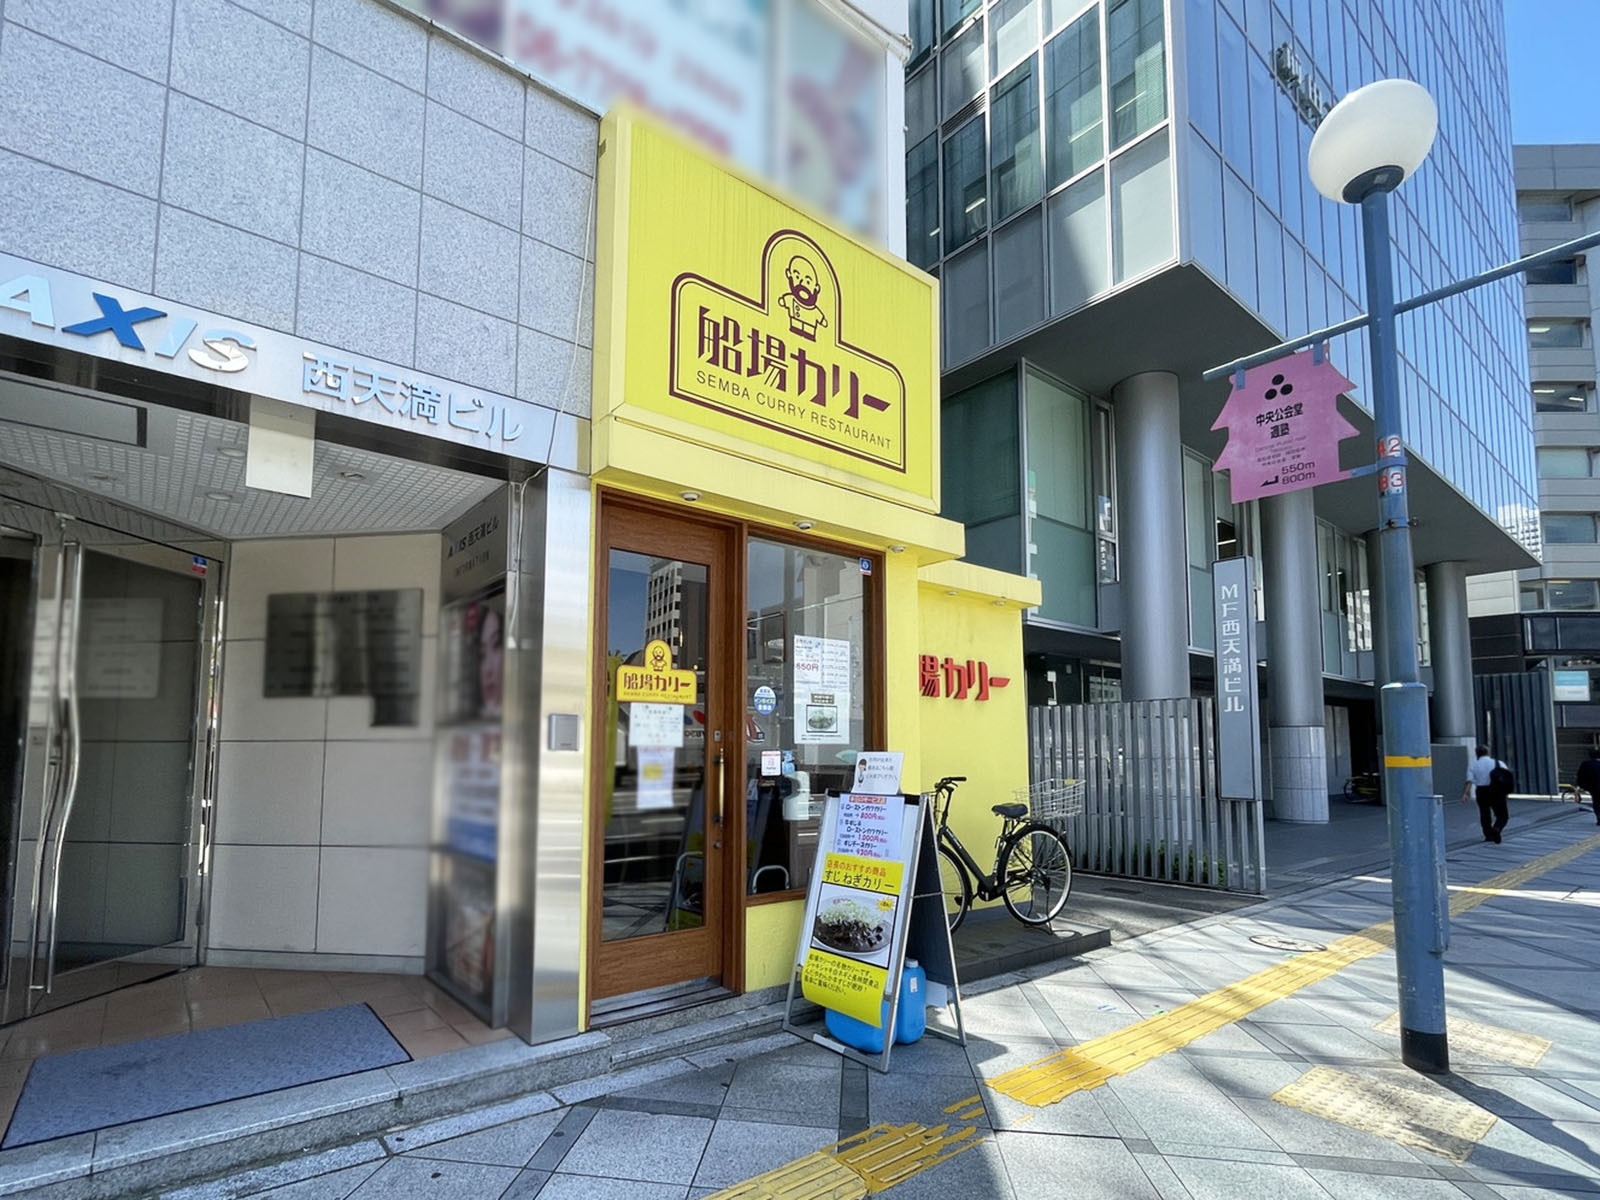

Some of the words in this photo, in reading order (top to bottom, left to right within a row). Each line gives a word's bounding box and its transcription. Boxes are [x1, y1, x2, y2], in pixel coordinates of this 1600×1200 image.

[0, 273, 257, 373] AXIS
[698, 305, 891, 419] 船場カリー
[302, 351, 524, 442] 西天満ビル
[696, 370, 750, 400] SEMBA
[756, 392, 806, 419] CURRY
[810, 411, 892, 450] RESTAURANT
[1255, 402, 1304, 427] 中央公会堂
[1281, 461, 1315, 475] 550m
[1282, 472, 1316, 485] 800m
[1220, 583, 1245, 713] MF西天満ビル
[624, 672, 691, 692] 船場カリー
[825, 870, 894, 890] すじねぎカリー
[827, 860, 887, 877] 店長のおすすめ商品
